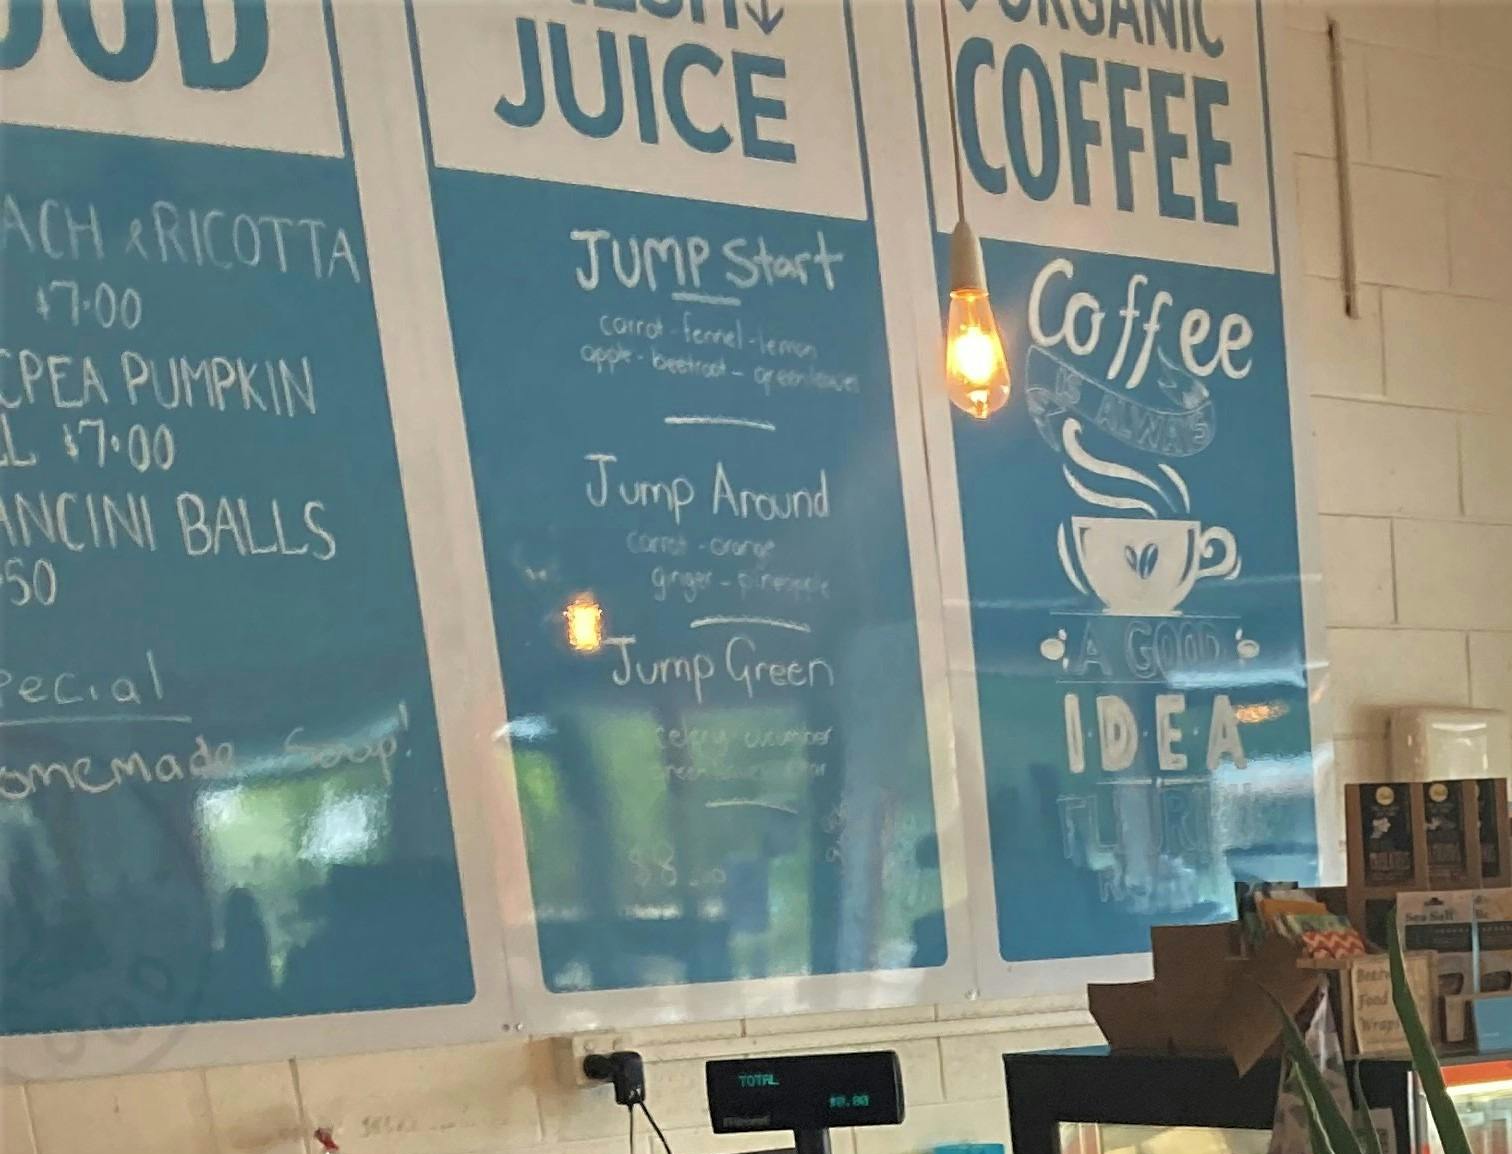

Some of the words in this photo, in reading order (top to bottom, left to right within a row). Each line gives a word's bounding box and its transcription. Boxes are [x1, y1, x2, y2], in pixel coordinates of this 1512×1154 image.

[494, 17, 796, 163] JUICE
[955, 37, 1238, 226] COFFEE
[151, 201, 360, 283] RICOTTA
[570, 229, 709, 292] JUMP
[722, 231, 844, 290] Start
[1029, 258, 1253, 389] Coffee
[120, 351, 317, 417] PUMPKIN
[583, 453, 695, 526] Jump
[712, 461, 831, 520] Around
[176, 491, 337, 561] BALLS
[602, 636, 715, 704] Jump
[725, 637, 834, 699] Green
[737, 1073, 780, 1088] TOTAL
